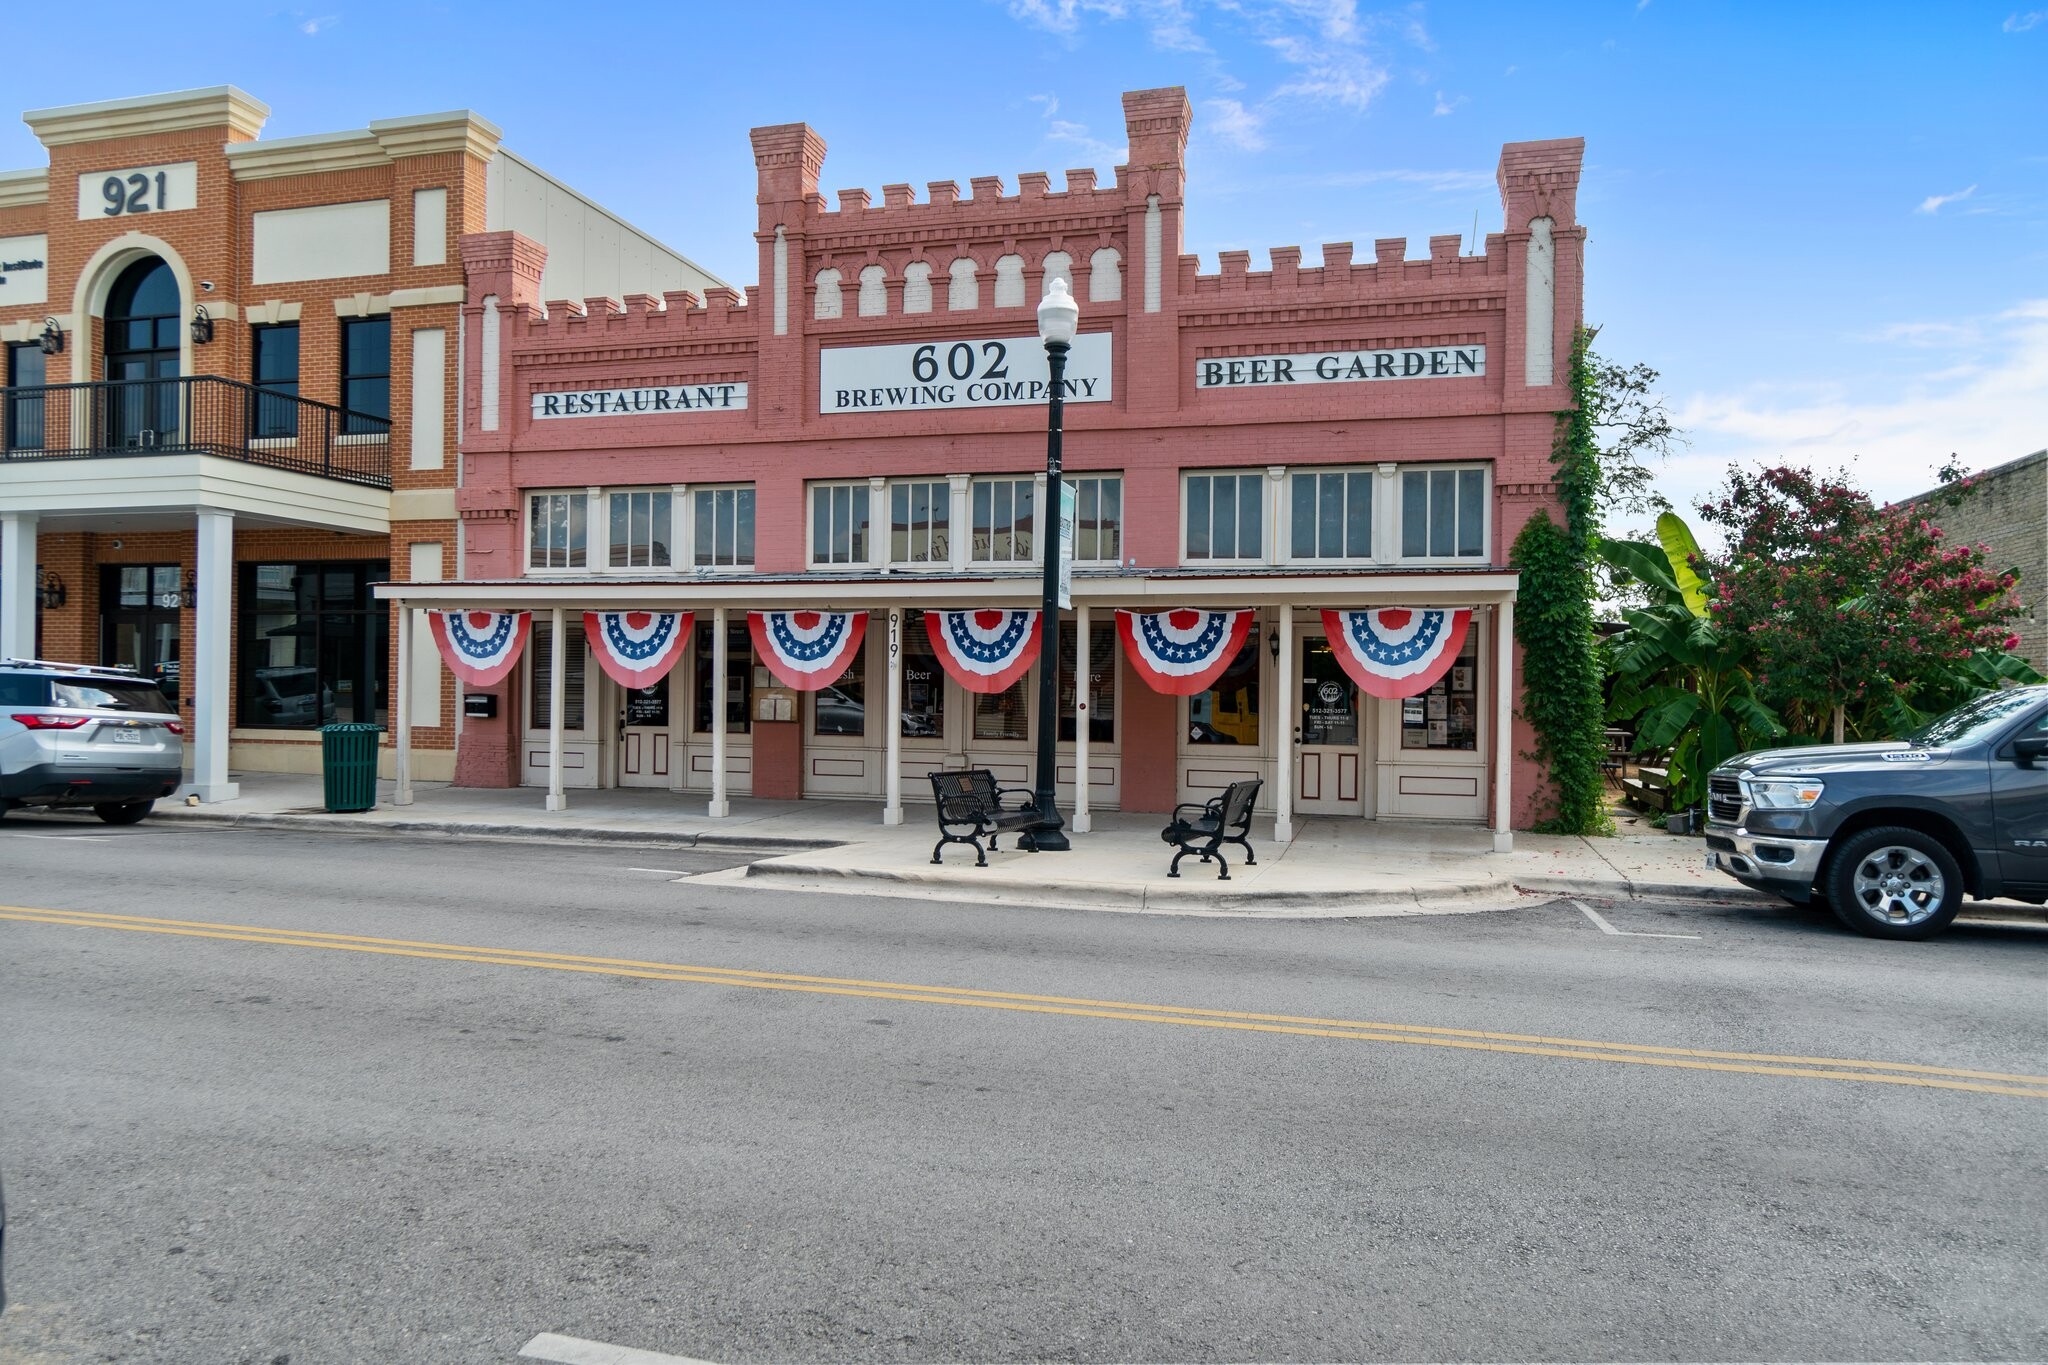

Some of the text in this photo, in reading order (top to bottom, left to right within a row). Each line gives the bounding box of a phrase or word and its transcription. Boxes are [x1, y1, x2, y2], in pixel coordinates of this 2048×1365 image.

[103, 170, 167, 216] 921
[912, 341, 1009, 383] 602
[1203, 349, 1479, 386] BEER GARDEN
[542, 385, 736, 415] RESTAURANT
[835, 385, 956, 408] BREWING
[162, 594, 182, 608] 92
[890, 613, 899, 658] 919
[905, 669, 932, 681] Beer
[1323, 687, 1338, 695] 602
